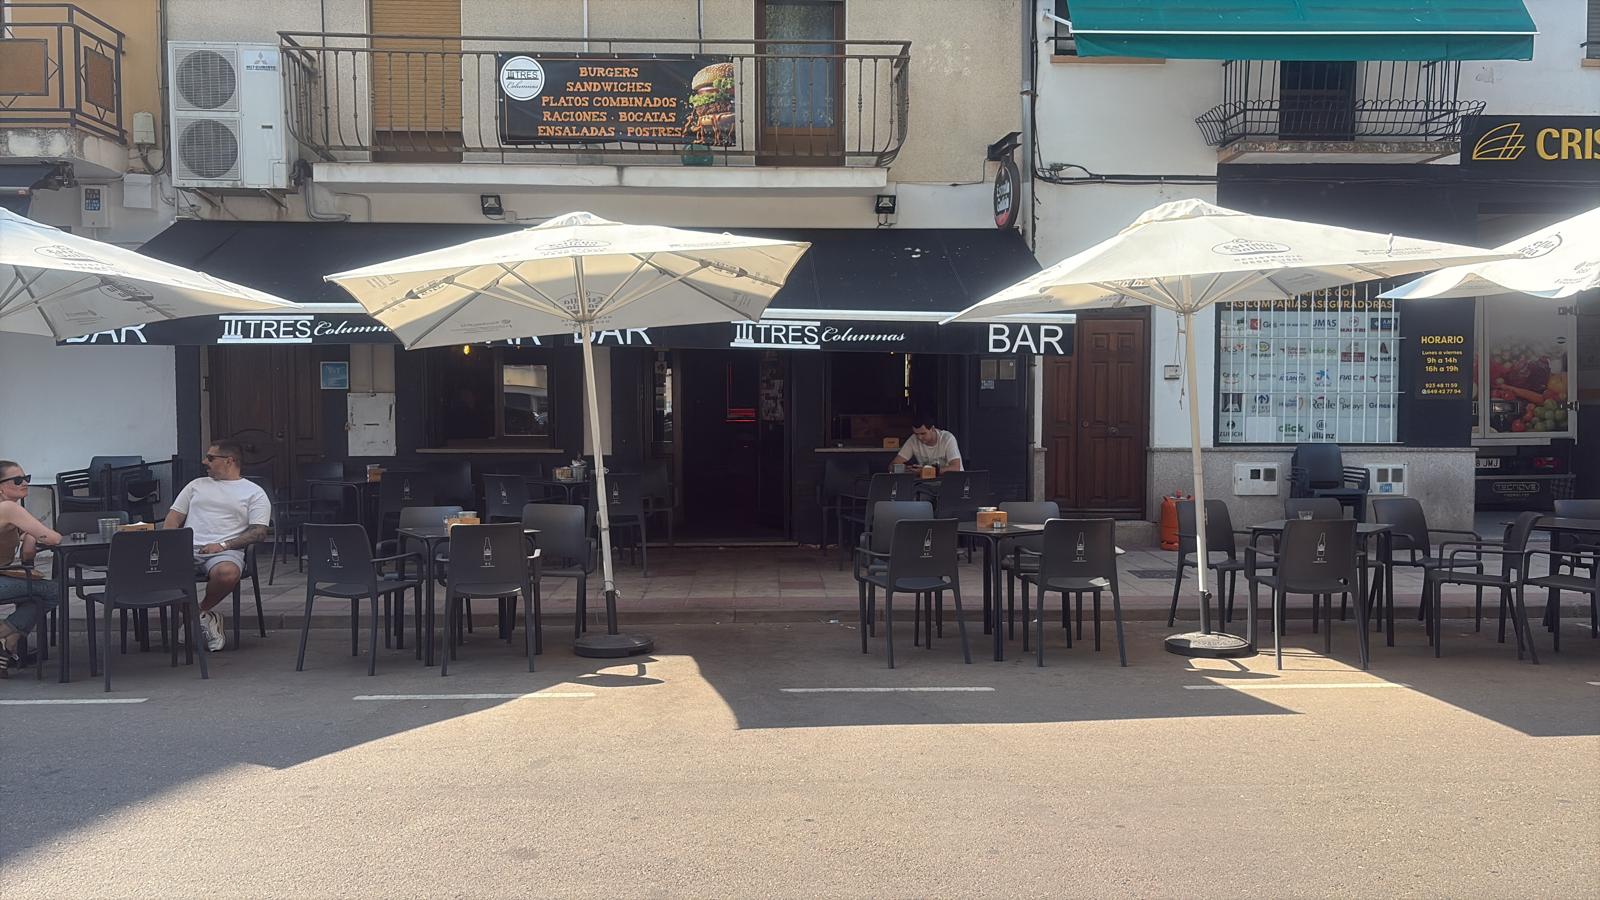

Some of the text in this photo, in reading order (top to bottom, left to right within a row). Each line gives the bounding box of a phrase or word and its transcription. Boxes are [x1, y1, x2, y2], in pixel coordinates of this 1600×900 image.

[579, 66, 639, 77] BURGERS
[566, 81, 652, 93] SANDWICHES
[541, 96, 677, 108] PLATOS COMBINADOS
[542, 111, 676, 122] RACIONES BOCATAS
[537, 126, 615, 137] ENSALADAS
[246, 320, 311, 338] TRES
[756, 324, 906, 345] TRES Columnas
[989, 323, 1064, 354] BAR
[1420, 335, 1464, 344] HORARIO
[1425, 365, 1438, 373] 16h
[1446, 365, 1459, 373] 19h
